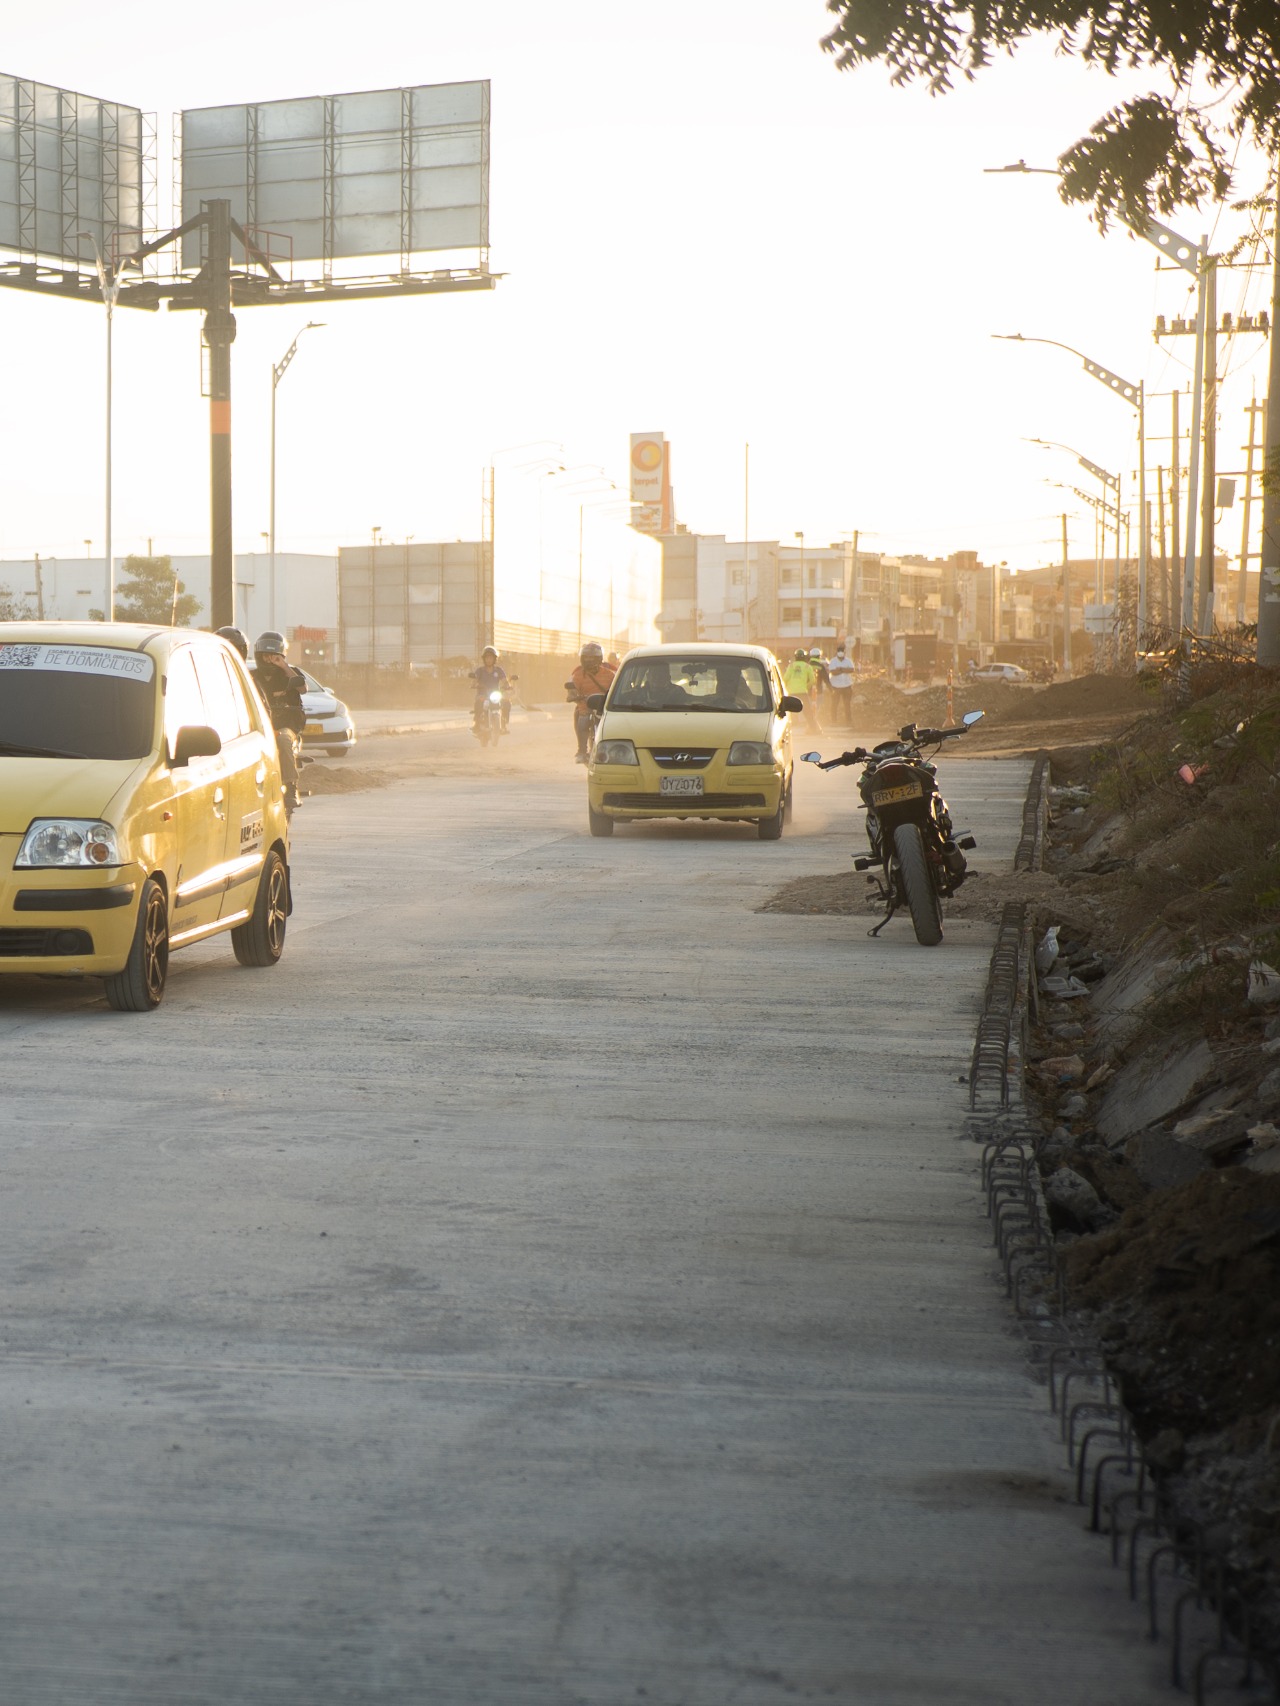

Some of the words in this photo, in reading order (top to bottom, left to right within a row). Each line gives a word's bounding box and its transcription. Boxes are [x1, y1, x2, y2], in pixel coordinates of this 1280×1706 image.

[44, 653, 62, 665] DE
[66, 654, 144, 674] DOMICILIOS
[112, 654, 146, 664] DIRECTORIO
